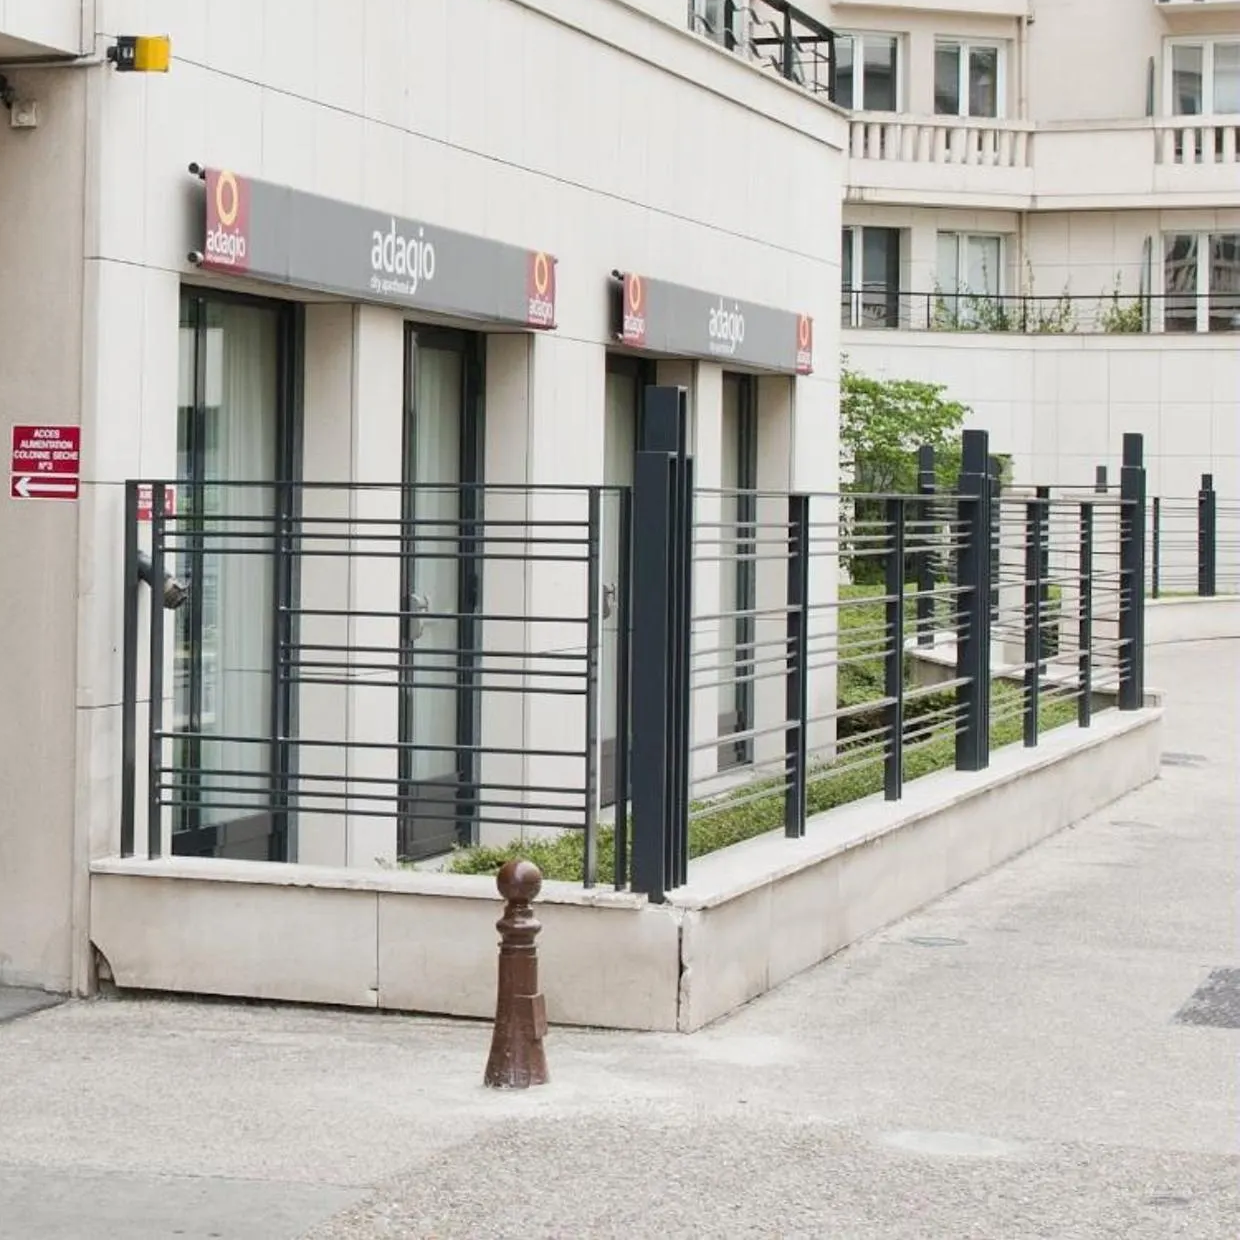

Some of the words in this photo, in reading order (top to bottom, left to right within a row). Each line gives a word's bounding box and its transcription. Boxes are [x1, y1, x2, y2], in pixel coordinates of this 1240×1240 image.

[206, 222, 246, 265] adagio
[371, 217, 435, 295] adagio
[709, 297, 745, 355] adagio
